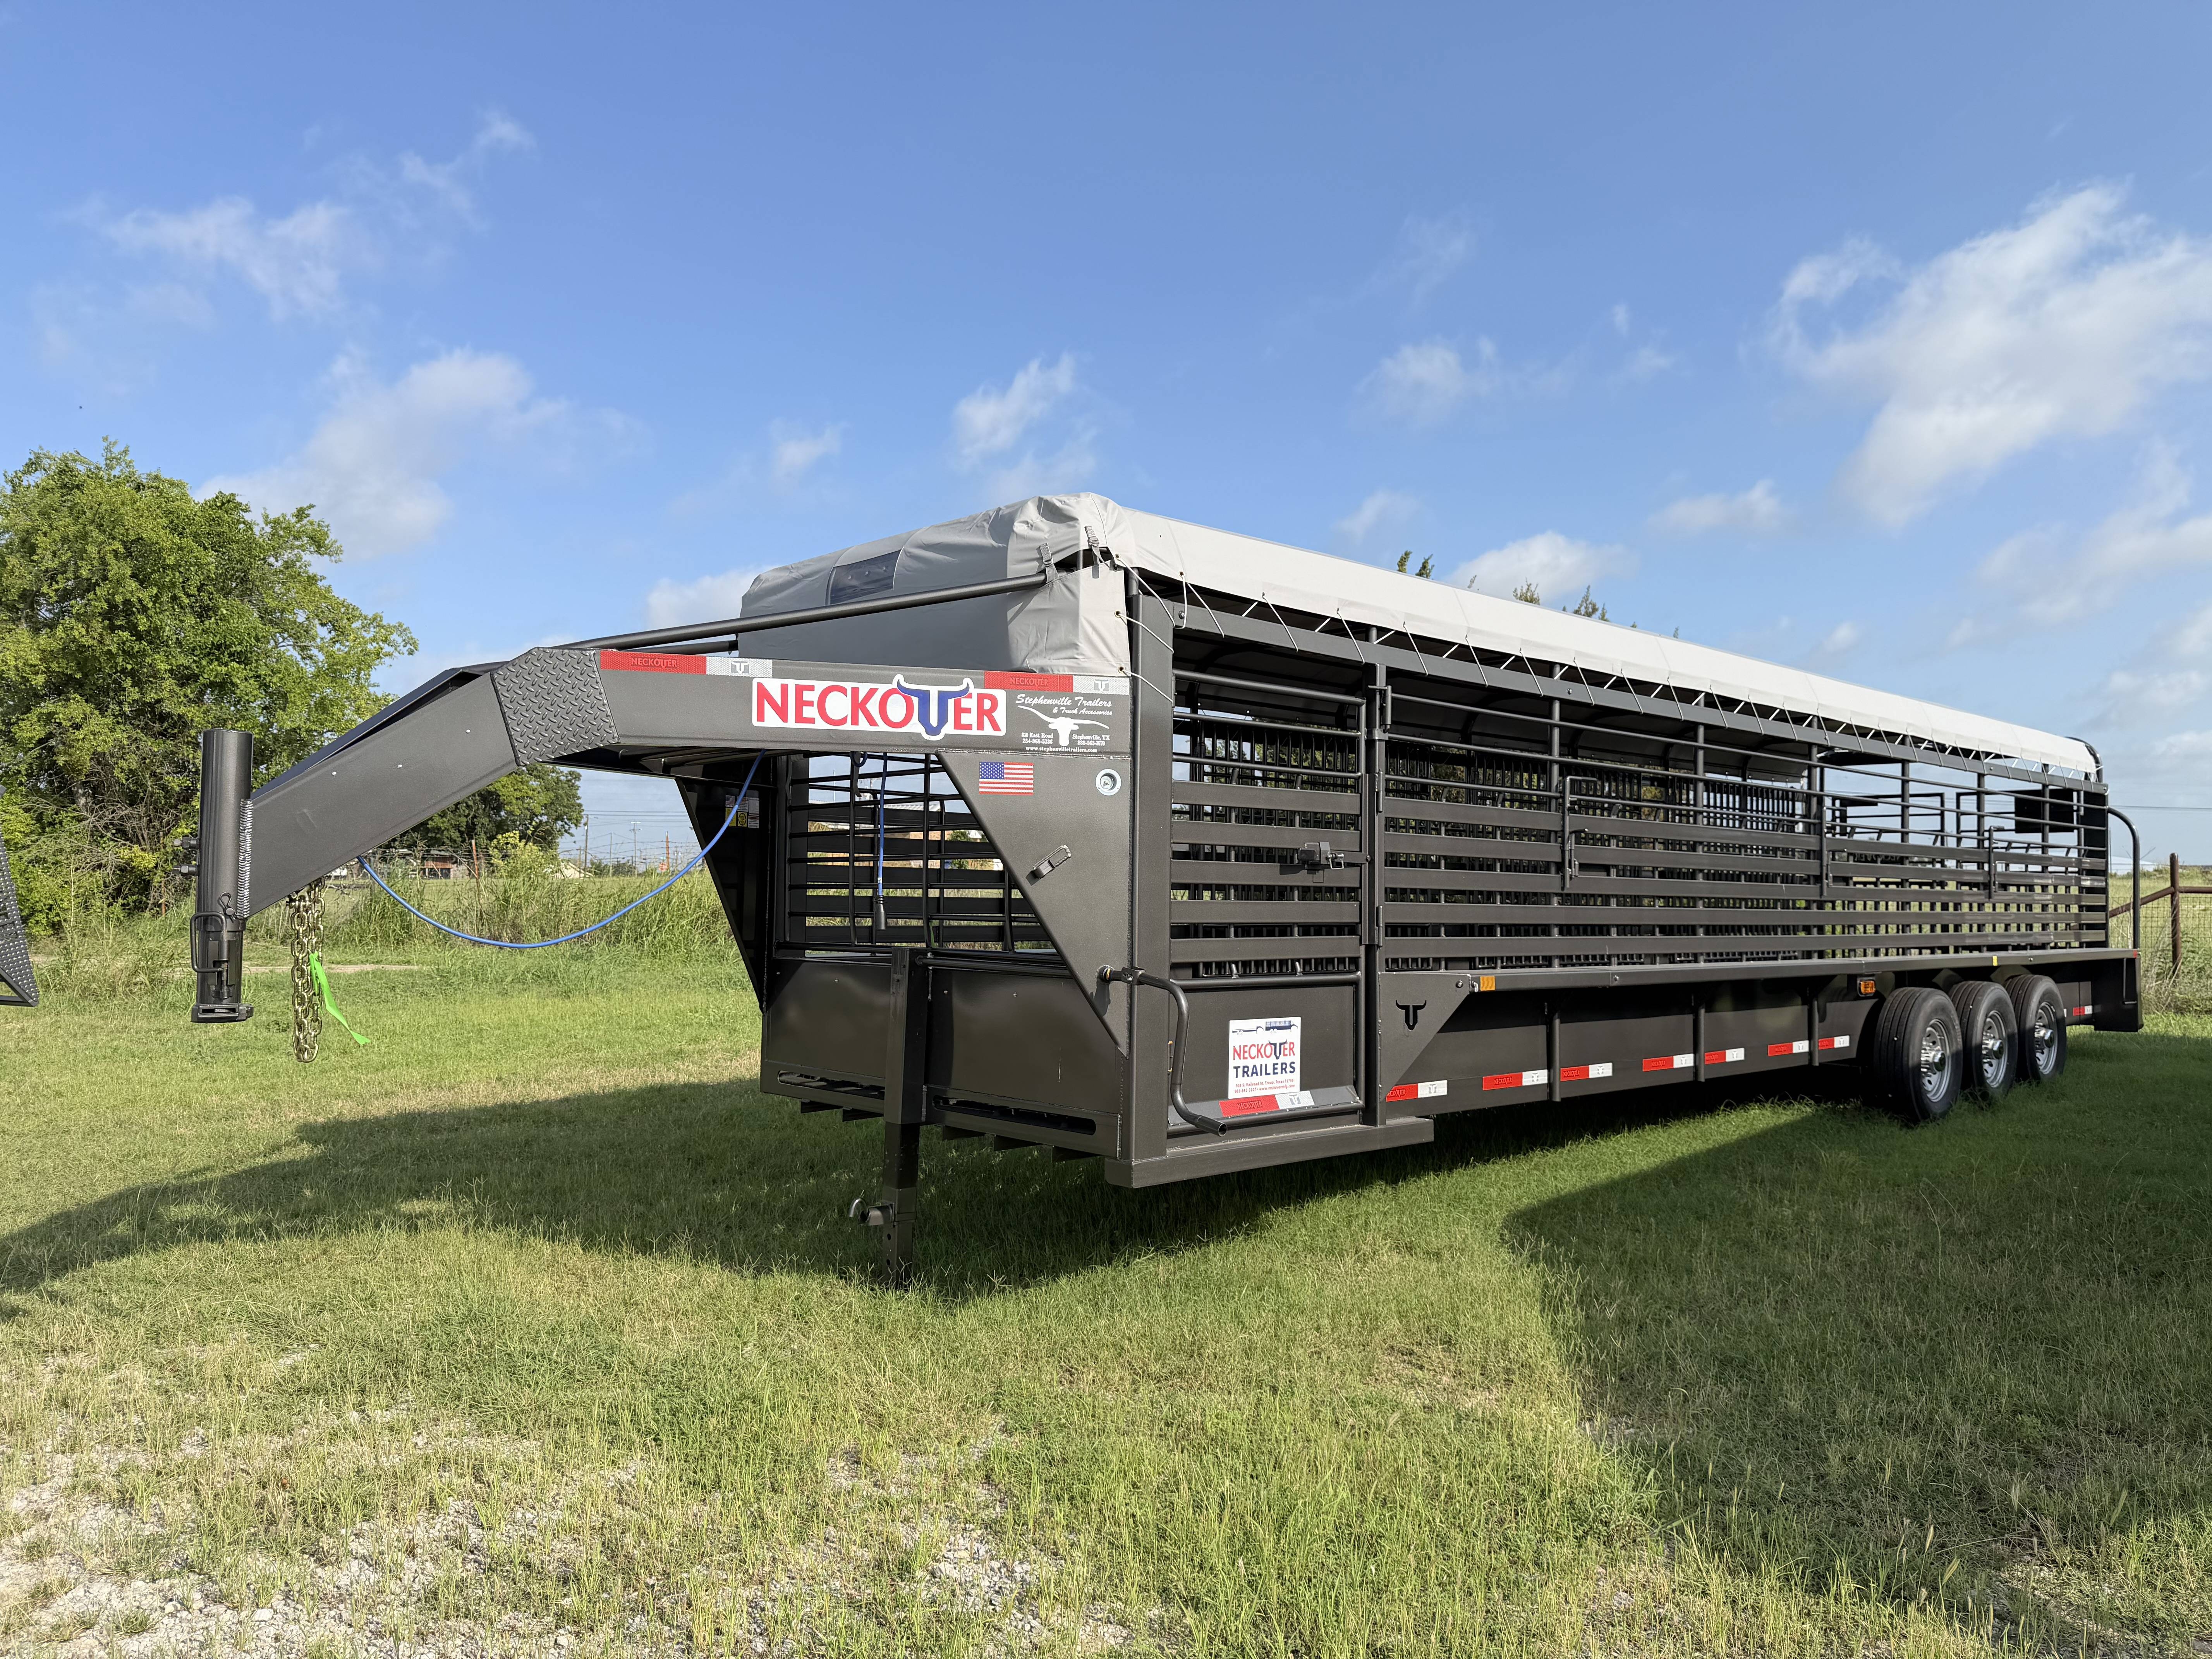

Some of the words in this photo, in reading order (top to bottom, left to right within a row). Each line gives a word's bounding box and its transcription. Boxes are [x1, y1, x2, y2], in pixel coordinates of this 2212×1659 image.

[631, 657, 677, 669] NECKOVER
[757, 682, 1001, 736] NECKOVER
[1015, 694, 1072, 706] Stephenville
[1075, 696, 1112, 707] Trailers
[1233, 1039, 1295, 1060] NECKOVER
[1233, 1061, 1295, 1078] TRAILERS
